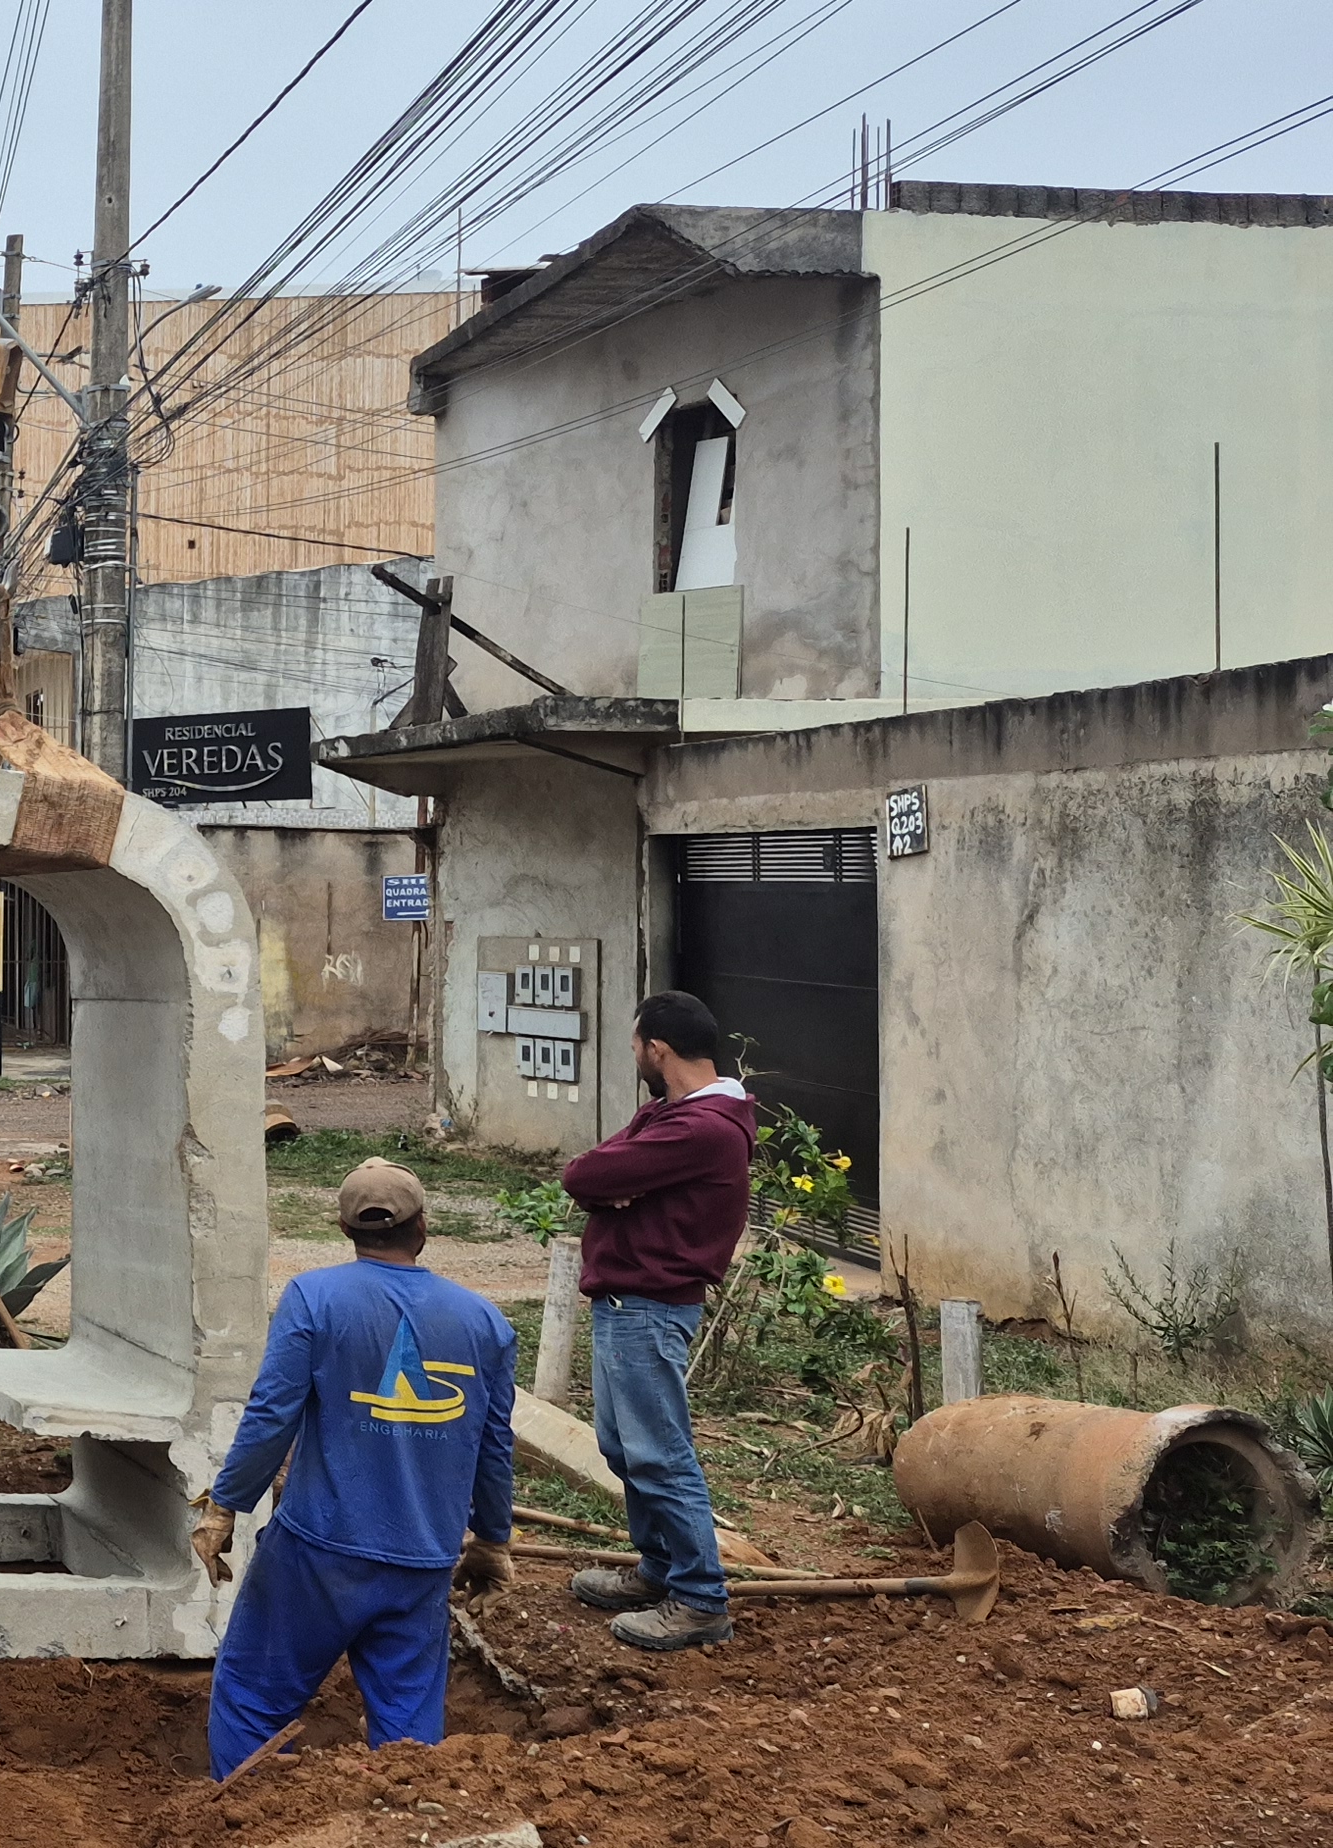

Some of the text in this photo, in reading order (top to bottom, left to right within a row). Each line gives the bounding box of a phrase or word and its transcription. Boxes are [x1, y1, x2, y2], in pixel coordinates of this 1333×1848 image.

[165, 722, 257, 741] RESIDENCIAL
[142, 741, 284, 777] VEREDAS
[142, 786, 188, 798] SHPS 204
[889, 791, 920, 817] SHPS
[891, 811, 923, 835] Q203
[385, 887, 427, 897] QUADRA
[386, 898, 429, 908] ENTRAD
[359, 1421, 449, 1440] ENGEHARIA
